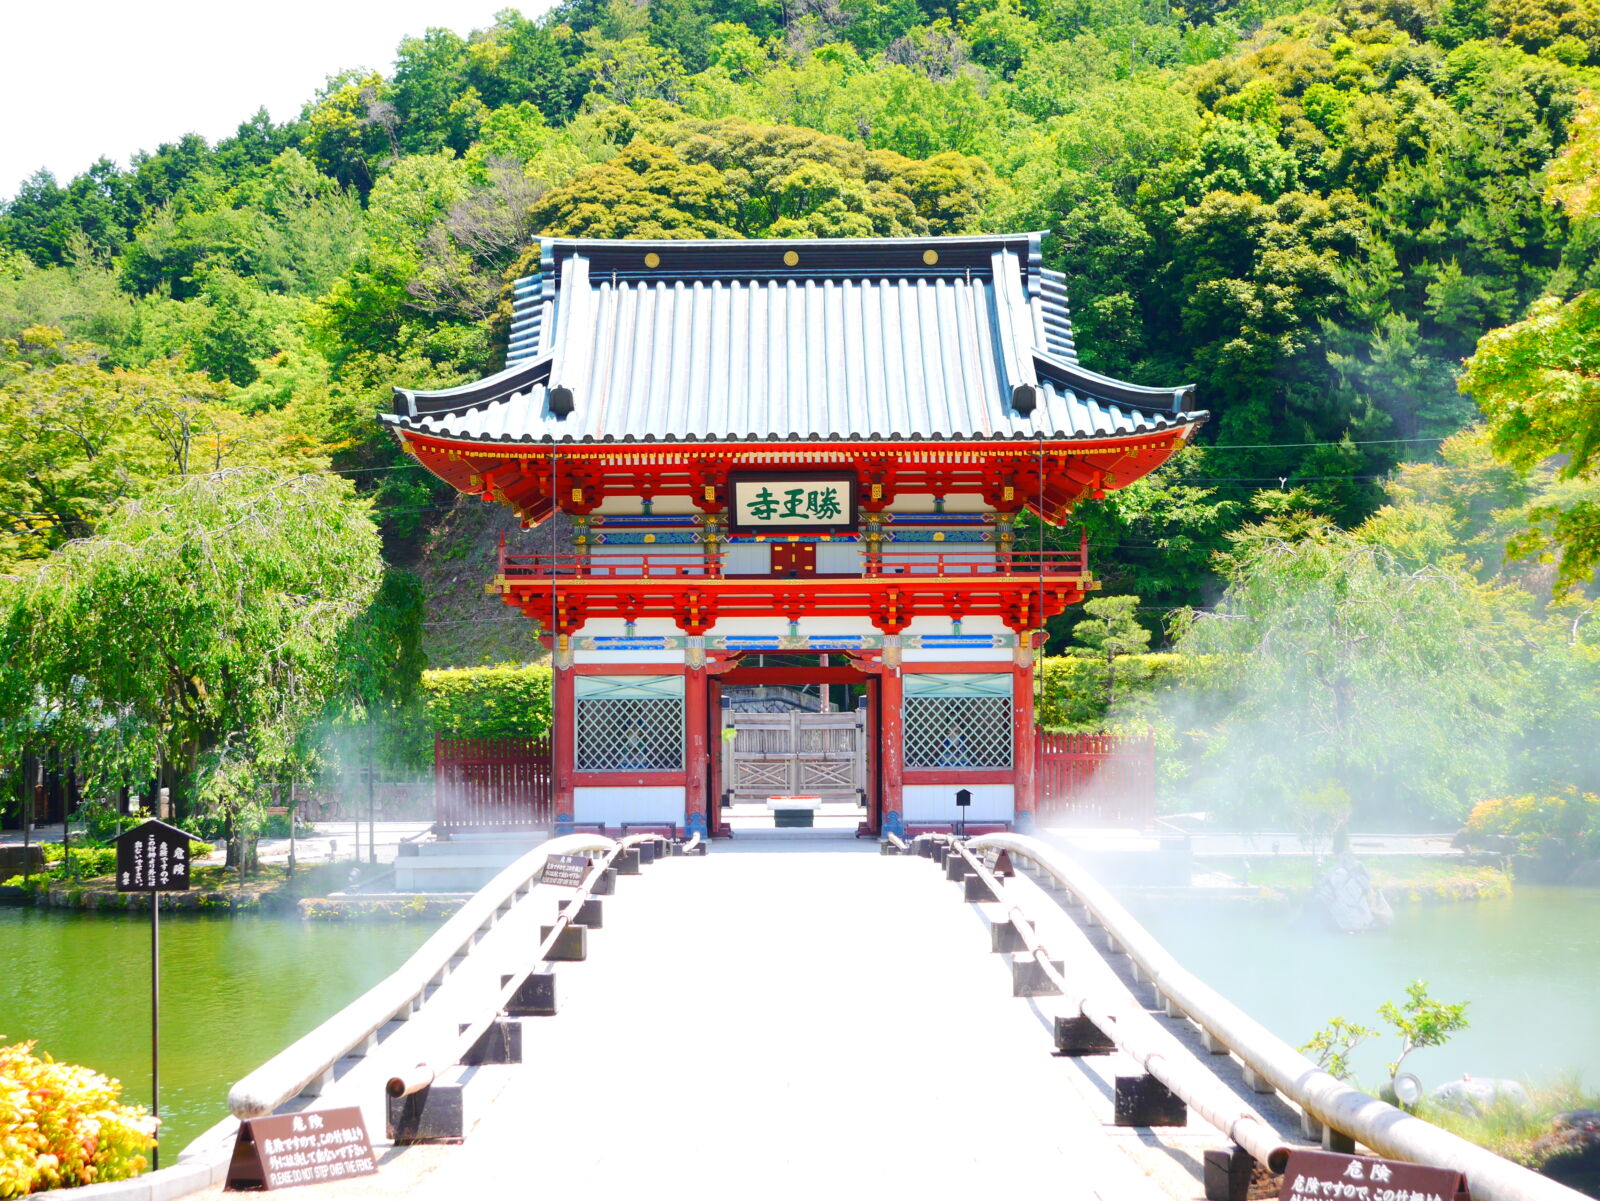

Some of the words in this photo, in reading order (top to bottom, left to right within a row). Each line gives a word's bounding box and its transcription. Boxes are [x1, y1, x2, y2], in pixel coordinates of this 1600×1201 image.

[173, 847, 185, 876] 危険
[293, 1113, 324, 1132] 危険
[270, 1170, 293, 1186] PLEASE
[293, 1169, 302, 1182] DO
[302, 1167, 314, 1180] NOT
[314, 1164, 328, 1179] STEP
[329, 1162, 345, 1176] OVER
[344, 1160, 356, 1174] THE
[355, 1157, 375, 1172] FENCE
[1343, 1159, 1393, 1183] 危険
